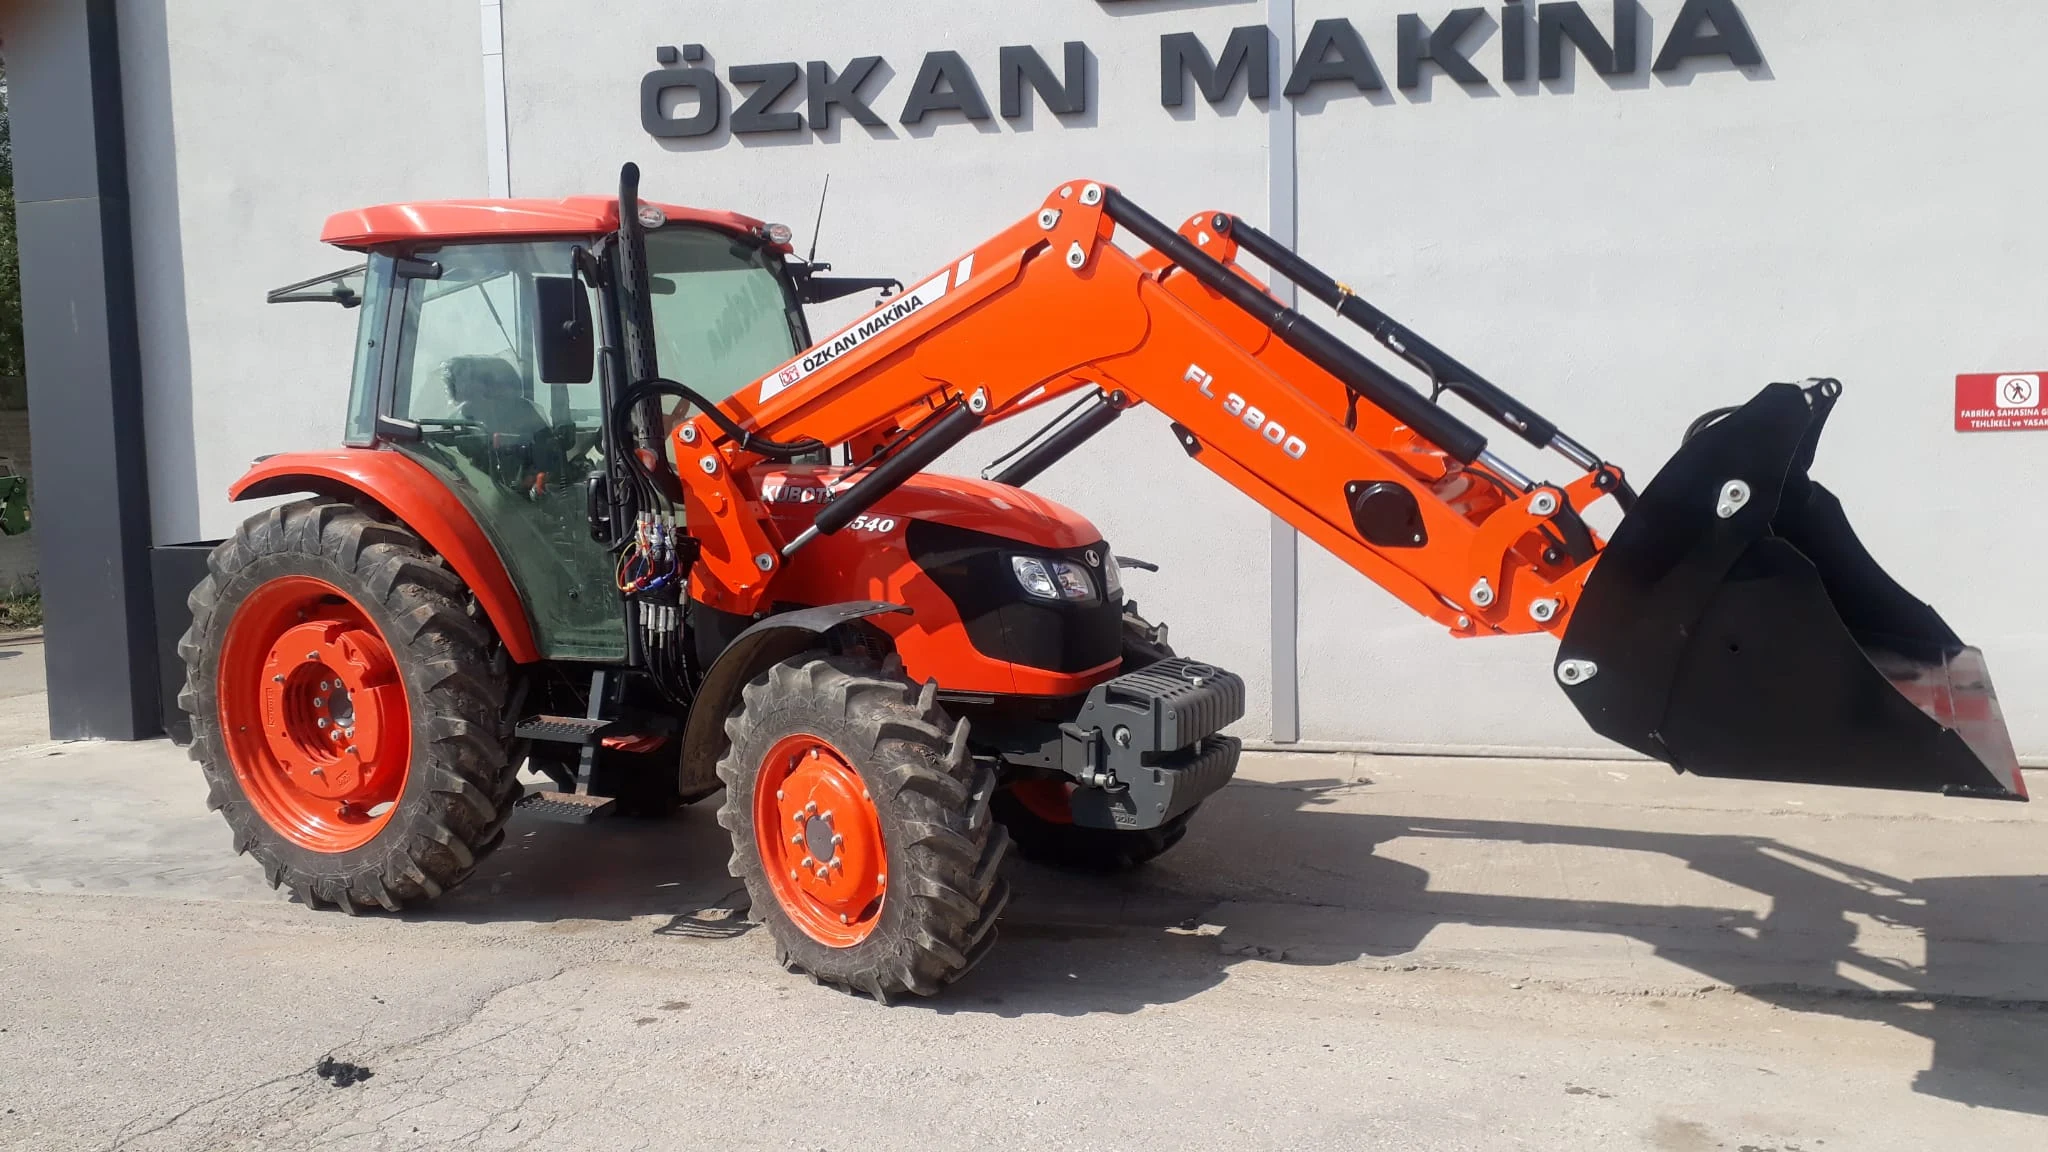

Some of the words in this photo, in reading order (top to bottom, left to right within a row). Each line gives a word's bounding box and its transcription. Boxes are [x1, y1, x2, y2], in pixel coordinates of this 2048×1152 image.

[640, 41, 1087, 138] ÖZKAN
[802, 333, 857, 373] ÖZKAN
[858, 294, 924, 342] MAKİNA
[1183, 363, 1214, 400] FL
[1222, 391, 1307, 460] 3800
[1960, 408, 1995, 418] FABRİKA
[1997, 408, 2039, 417] SAHASINA
[1971, 418, 2010, 428] TEHLİKELİ
[761, 485, 837, 503] KUBOTA
[846, 515, 895, 533] 540
